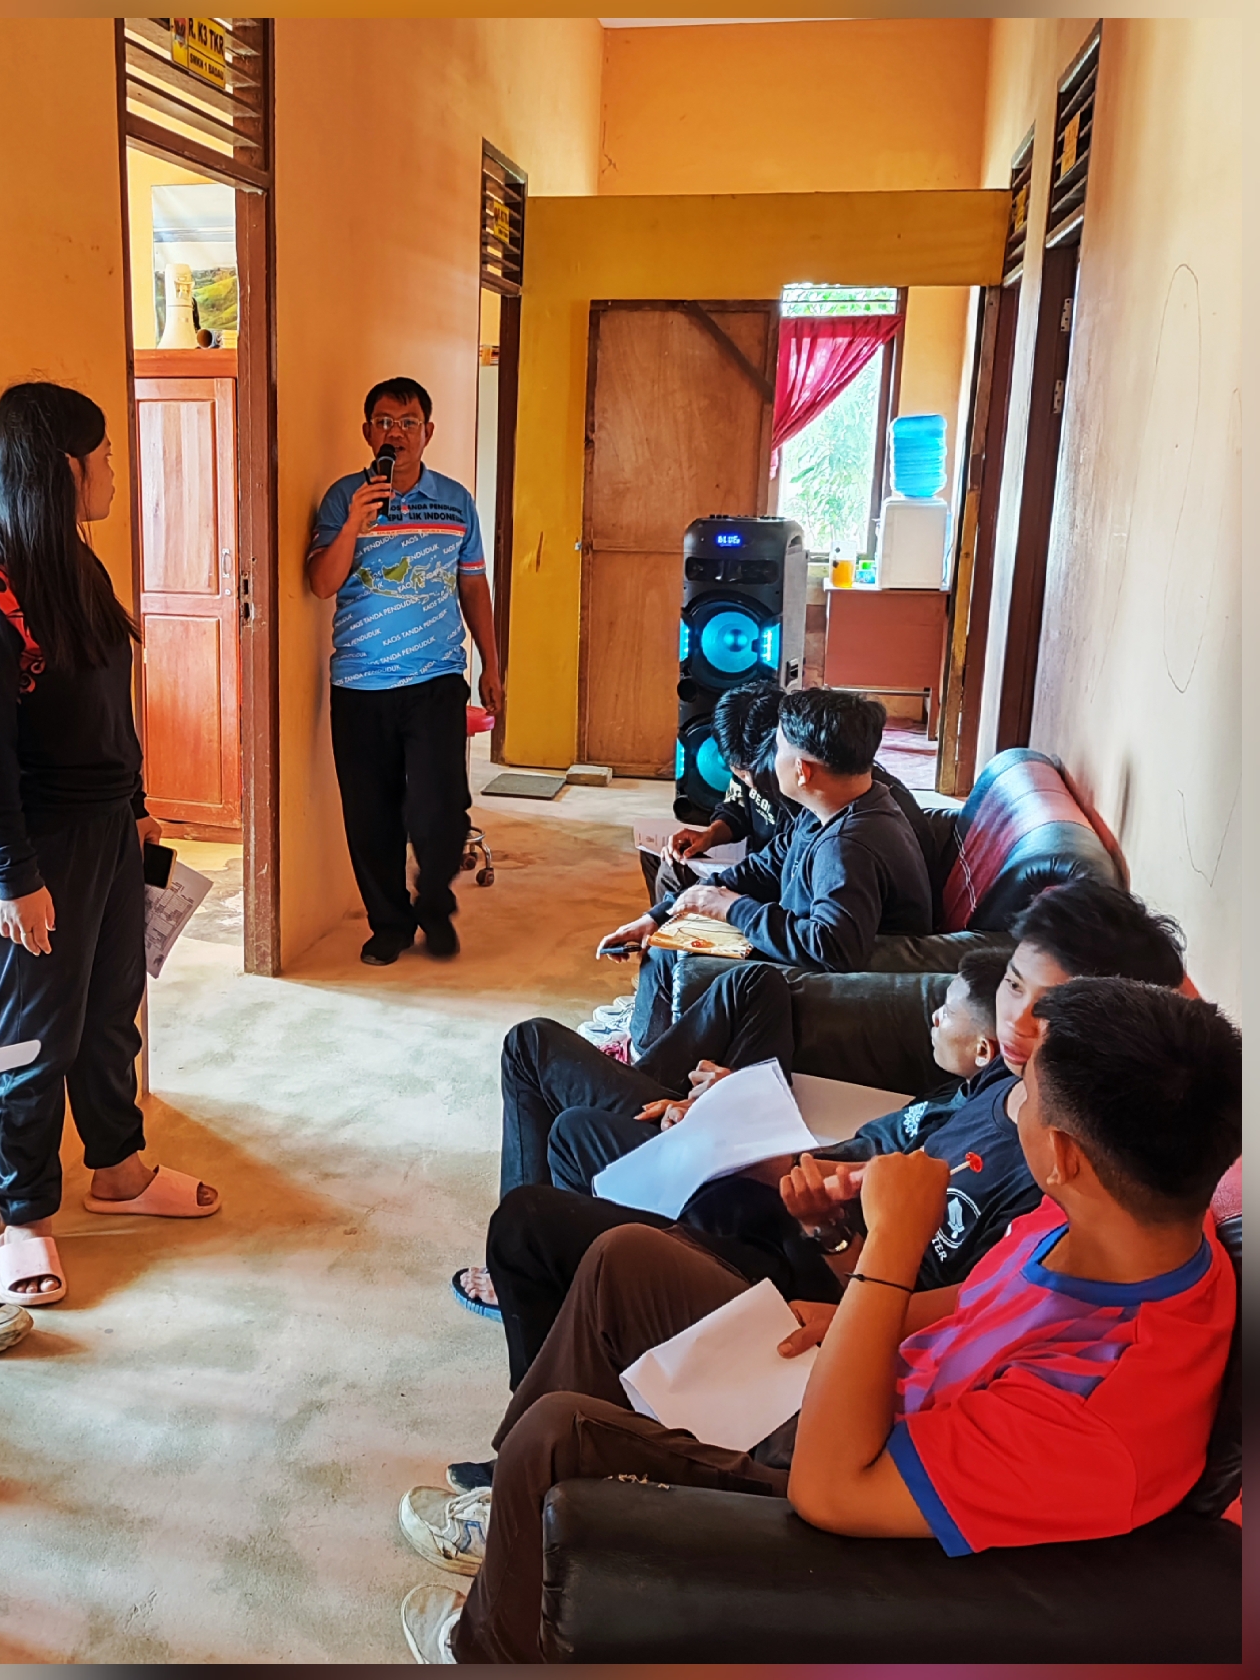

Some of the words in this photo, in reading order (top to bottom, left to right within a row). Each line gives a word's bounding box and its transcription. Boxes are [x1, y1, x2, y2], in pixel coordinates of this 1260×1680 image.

[198, 21, 207, 46] K3
[209, 29, 224, 56] TKR
[401, 535, 419, 548] KAOS
[397, 580, 414, 593] KAO
[363, 611, 383, 623] TANDA
[382, 634, 401, 646] KAOS
[401, 625, 423, 638] TANDA
[379, 652, 401, 664] TANDA
[401, 635, 436, 656] PENDUDUK
